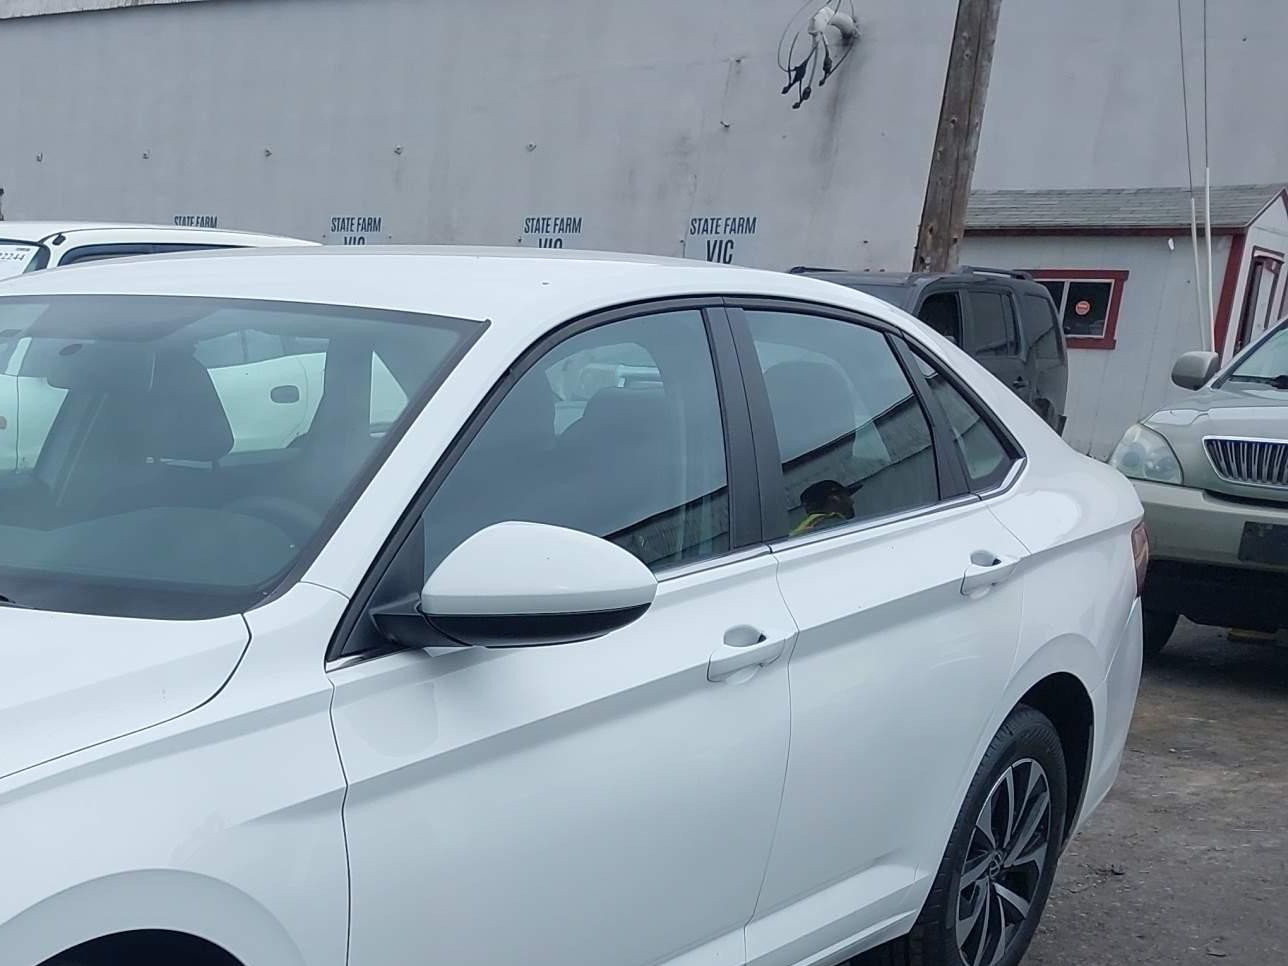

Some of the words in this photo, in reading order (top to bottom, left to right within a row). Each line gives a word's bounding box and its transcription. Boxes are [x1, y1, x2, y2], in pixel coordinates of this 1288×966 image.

[331, 217, 355, 233] STATE
[356, 217, 382, 233] FARM
[524, 217, 551, 234] STATE
[553, 217, 583, 234] FARM
[690, 217, 721, 236] STATE
[724, 216, 757, 235] FARM
[706, 239, 734, 265] VIC
